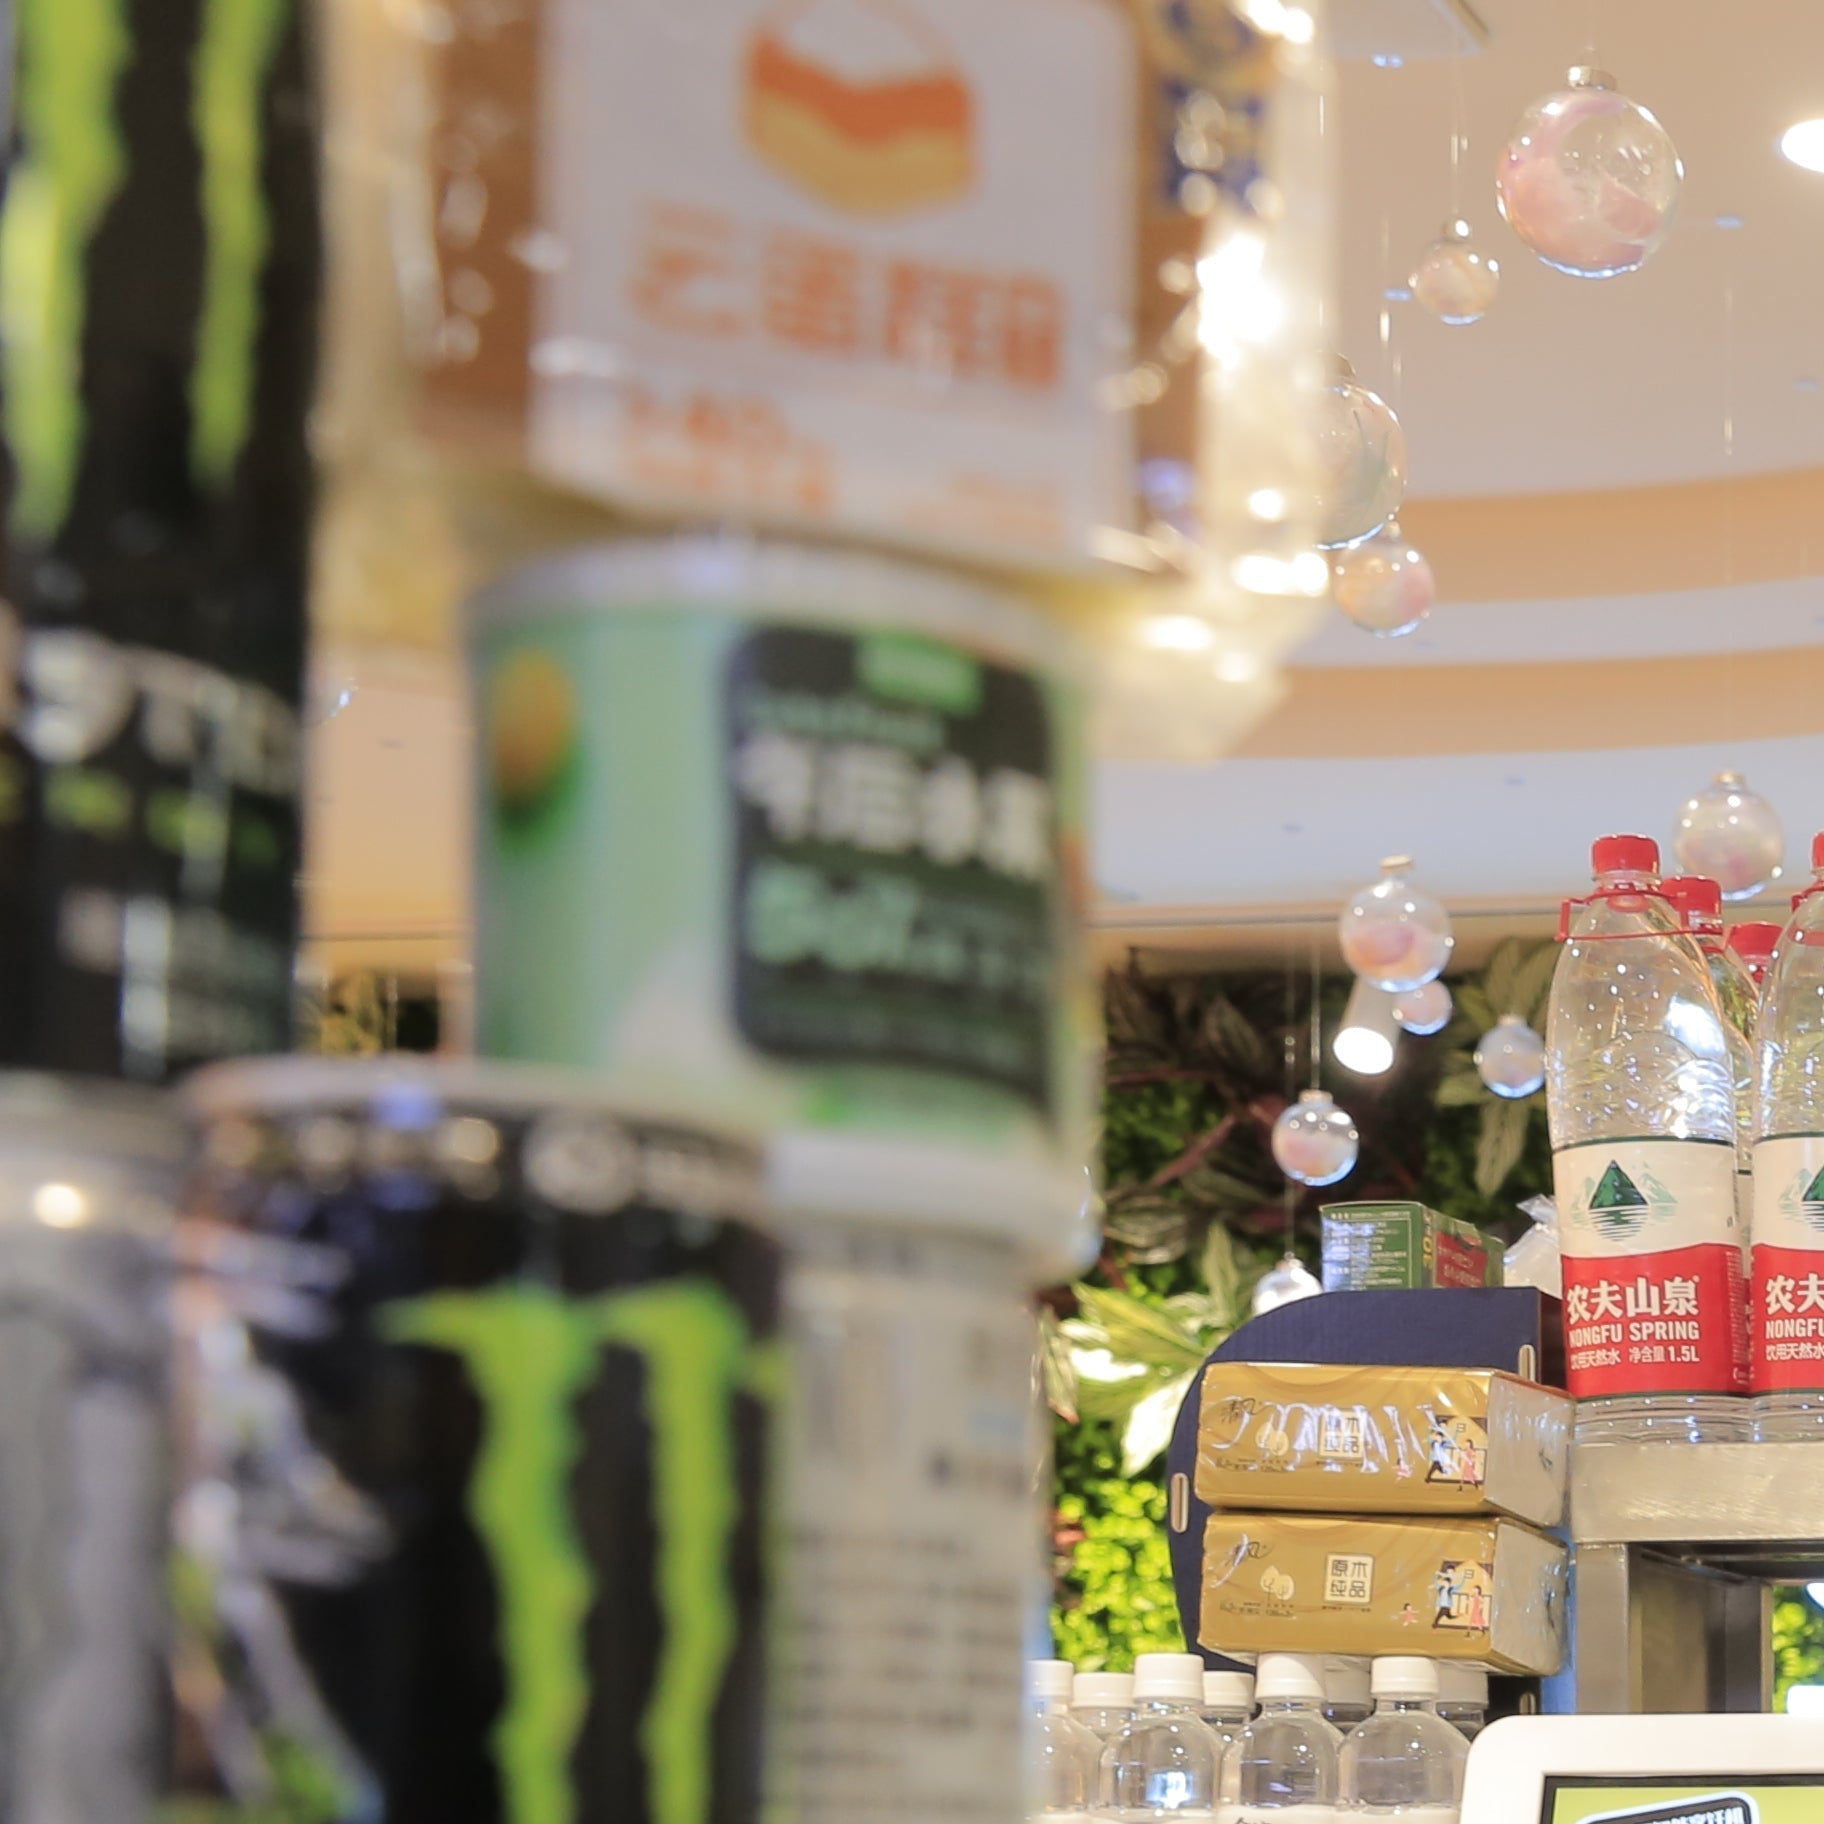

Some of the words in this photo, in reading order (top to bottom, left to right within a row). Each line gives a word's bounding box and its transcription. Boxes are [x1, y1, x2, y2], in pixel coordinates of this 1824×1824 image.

[1567, 1276, 1698, 1324] 农夫山泉
[1569, 1323, 1622, 1348] NONGFU
[1629, 1321, 1699, 1341] SPRING
[1331, 1560, 1367, 1578] 原木
